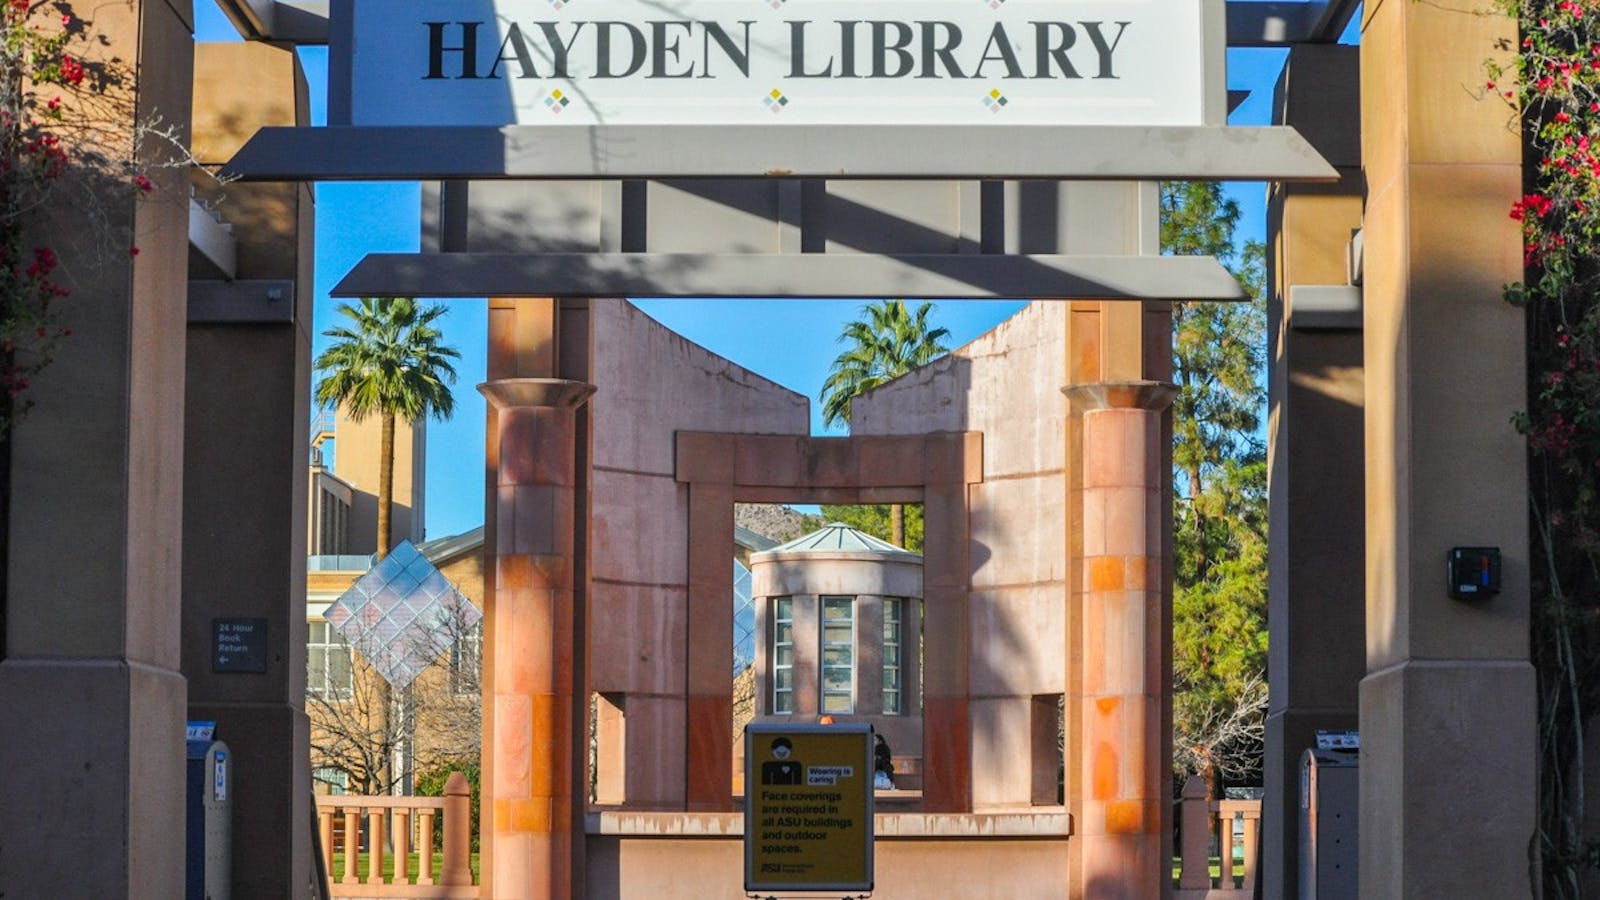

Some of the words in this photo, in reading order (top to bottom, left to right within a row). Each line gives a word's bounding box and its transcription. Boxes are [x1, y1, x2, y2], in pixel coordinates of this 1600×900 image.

[421, 20, 757, 80] HAYDEN
[783, 20, 1132, 80] LIBRARY
[233, 624, 254, 632] Hour
[218, 644, 248, 652] Return
[809, 768, 842, 776] Wearing
[809, 776, 834, 784] caring
[762, 791, 788, 800] Face
[790, 791, 842, 802] coverings
[762, 806, 779, 814] are
[781, 804, 826, 815] required
[829, 804, 838, 814] in
[762, 817, 775, 827] all
[777, 818, 801, 827] ASU
[804, 817, 853, 828] buildings
[762, 830, 782, 840] and
[784, 830, 828, 840] outdoor
[762, 843, 802, 854] spaces.
